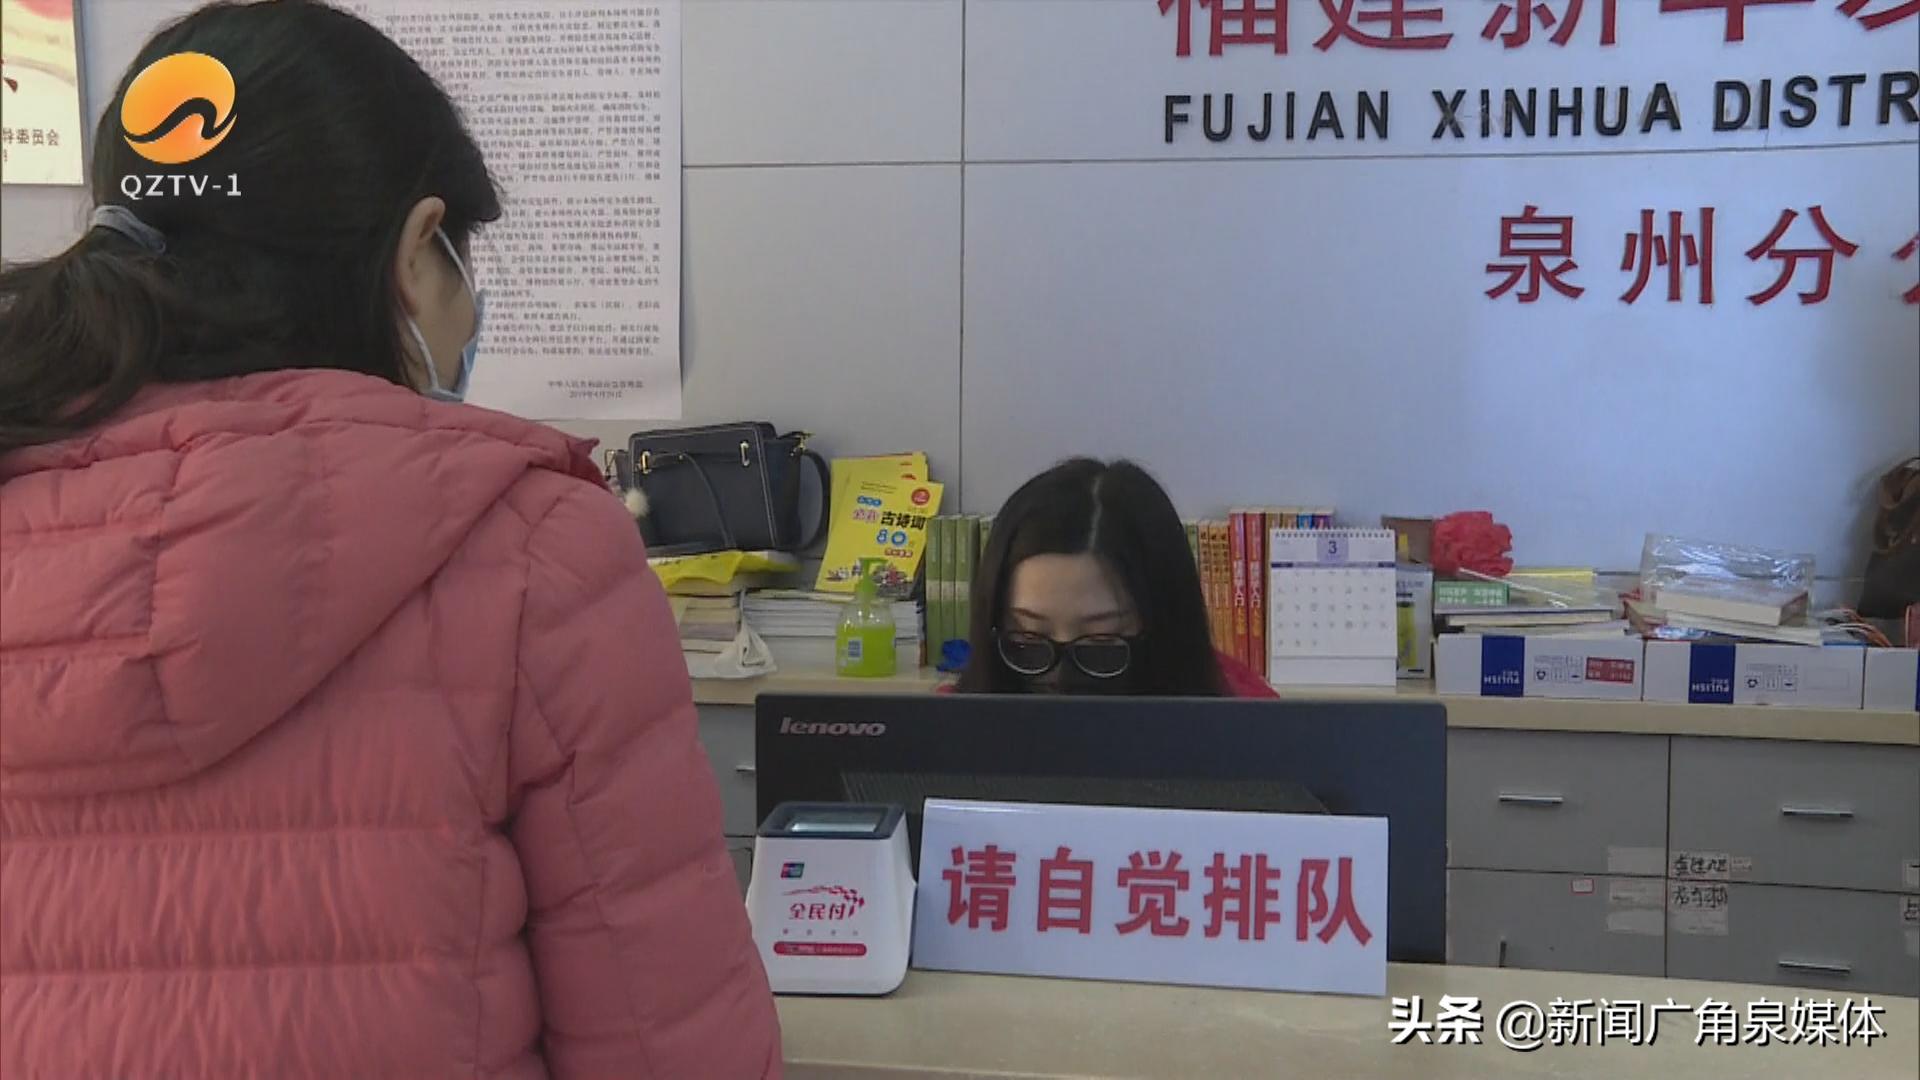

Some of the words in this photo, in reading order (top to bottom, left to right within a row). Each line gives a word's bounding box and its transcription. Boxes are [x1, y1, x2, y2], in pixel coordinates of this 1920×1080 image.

[1165, 90, 1388, 143] FUJIAN
[1431, 82, 1682, 138] XINHUA
[1712, 71, 1919, 132] DISTR
[1484, 204, 1919, 306] 泉州分
[1328, 541, 1337, 554] 3
[780, 717, 886, 736] lenovo
[789, 903, 846, 920] 全民付
[942, 845, 1373, 947] 请自觉排队
